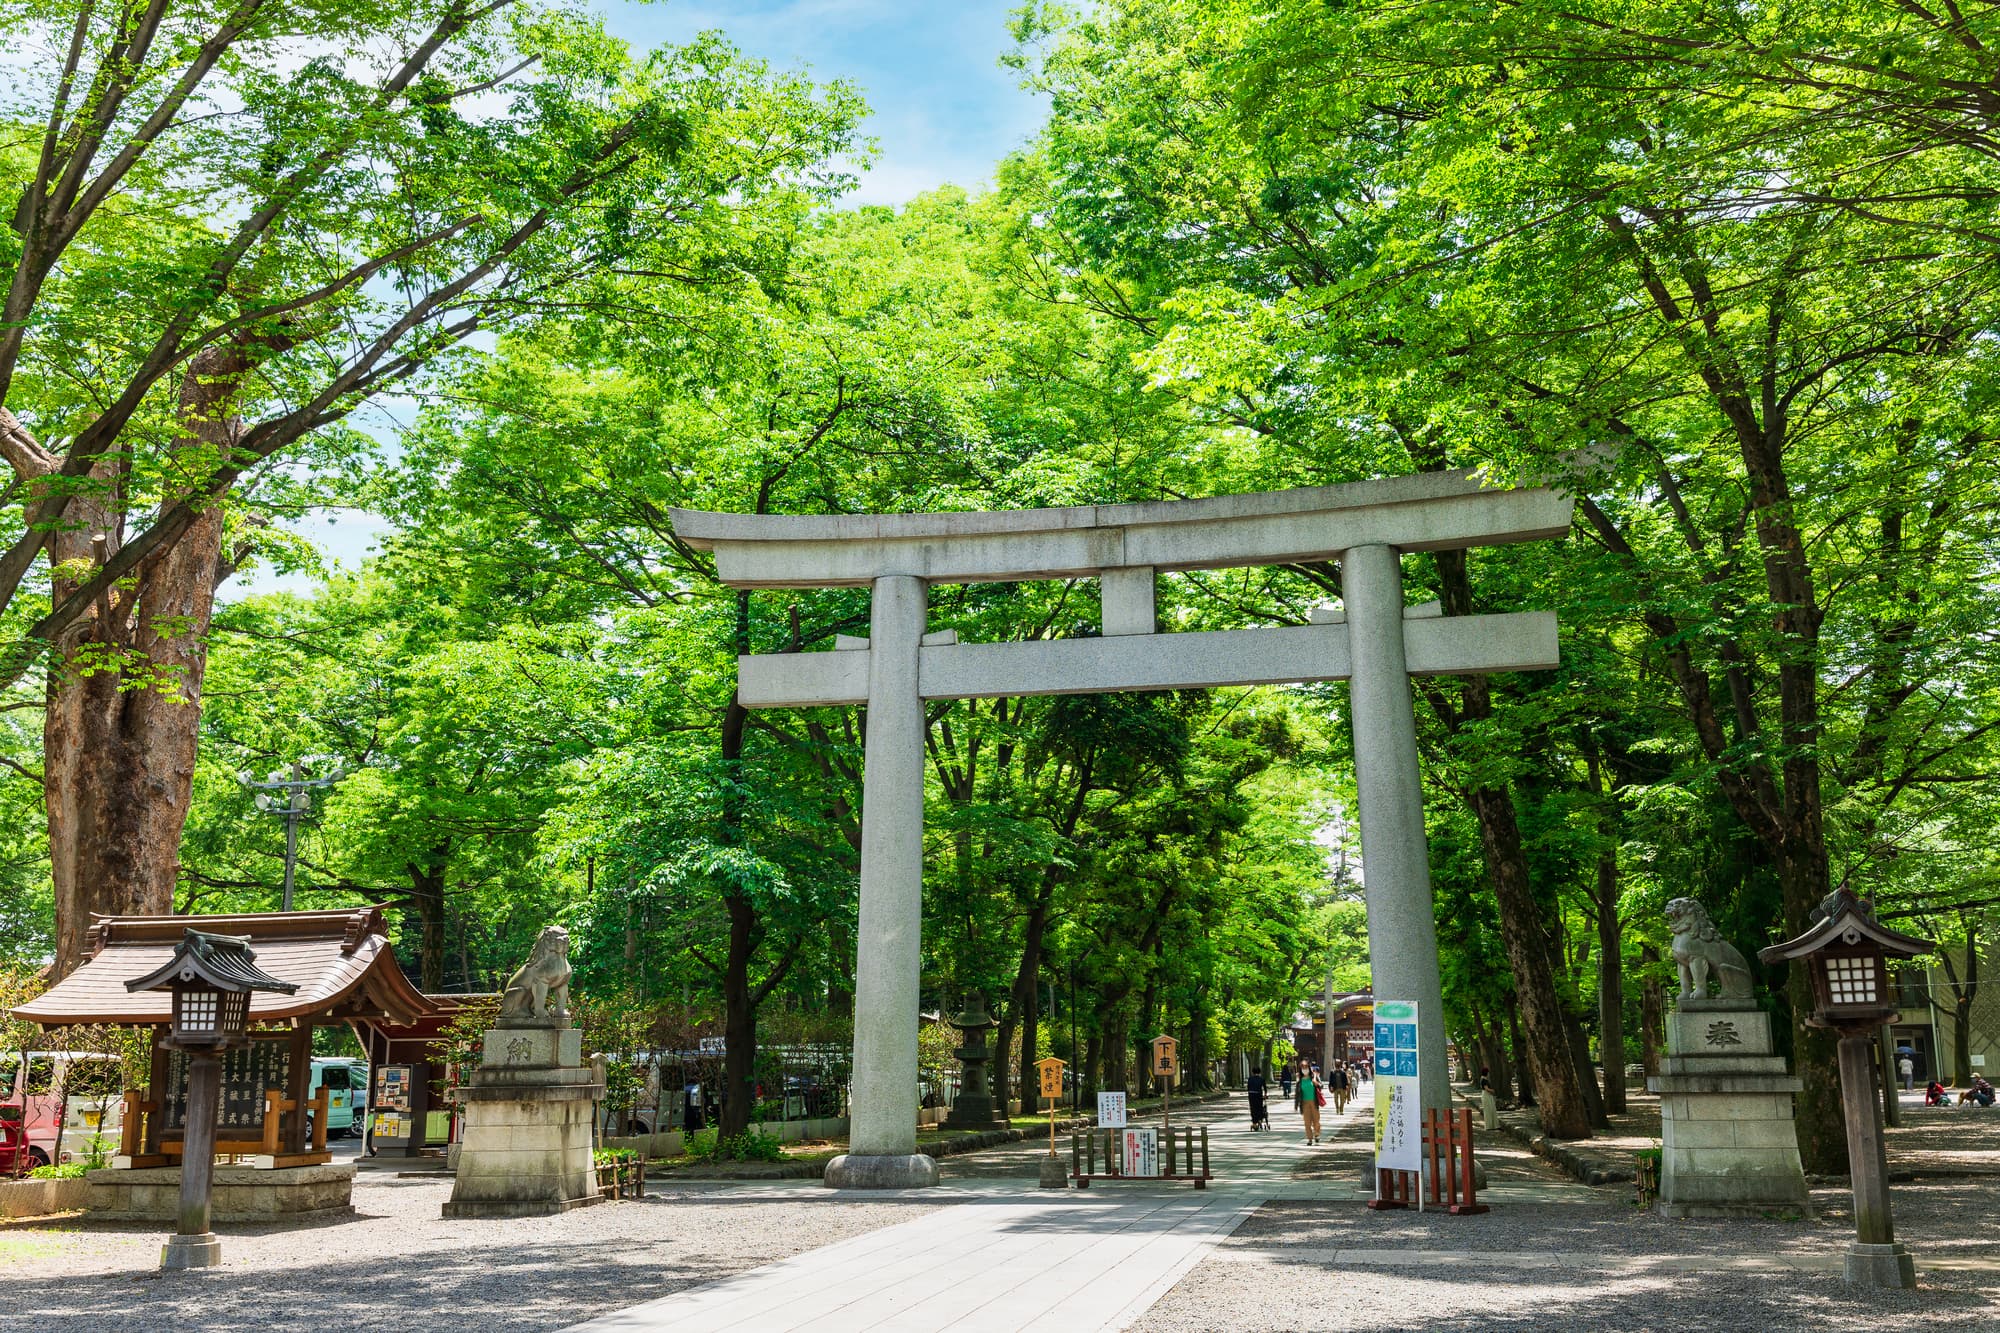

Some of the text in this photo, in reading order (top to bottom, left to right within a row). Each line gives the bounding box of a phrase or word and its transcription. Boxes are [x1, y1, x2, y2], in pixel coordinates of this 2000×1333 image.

[1705, 1020, 1742, 1048] 奉
[506, 1037, 533, 1065] 納
[1158, 1042, 1172, 1071] 下車
[1044, 1067, 1054, 1092] 禁煙
[1396, 1085, 1404, 1147] 皆様のご協力を
